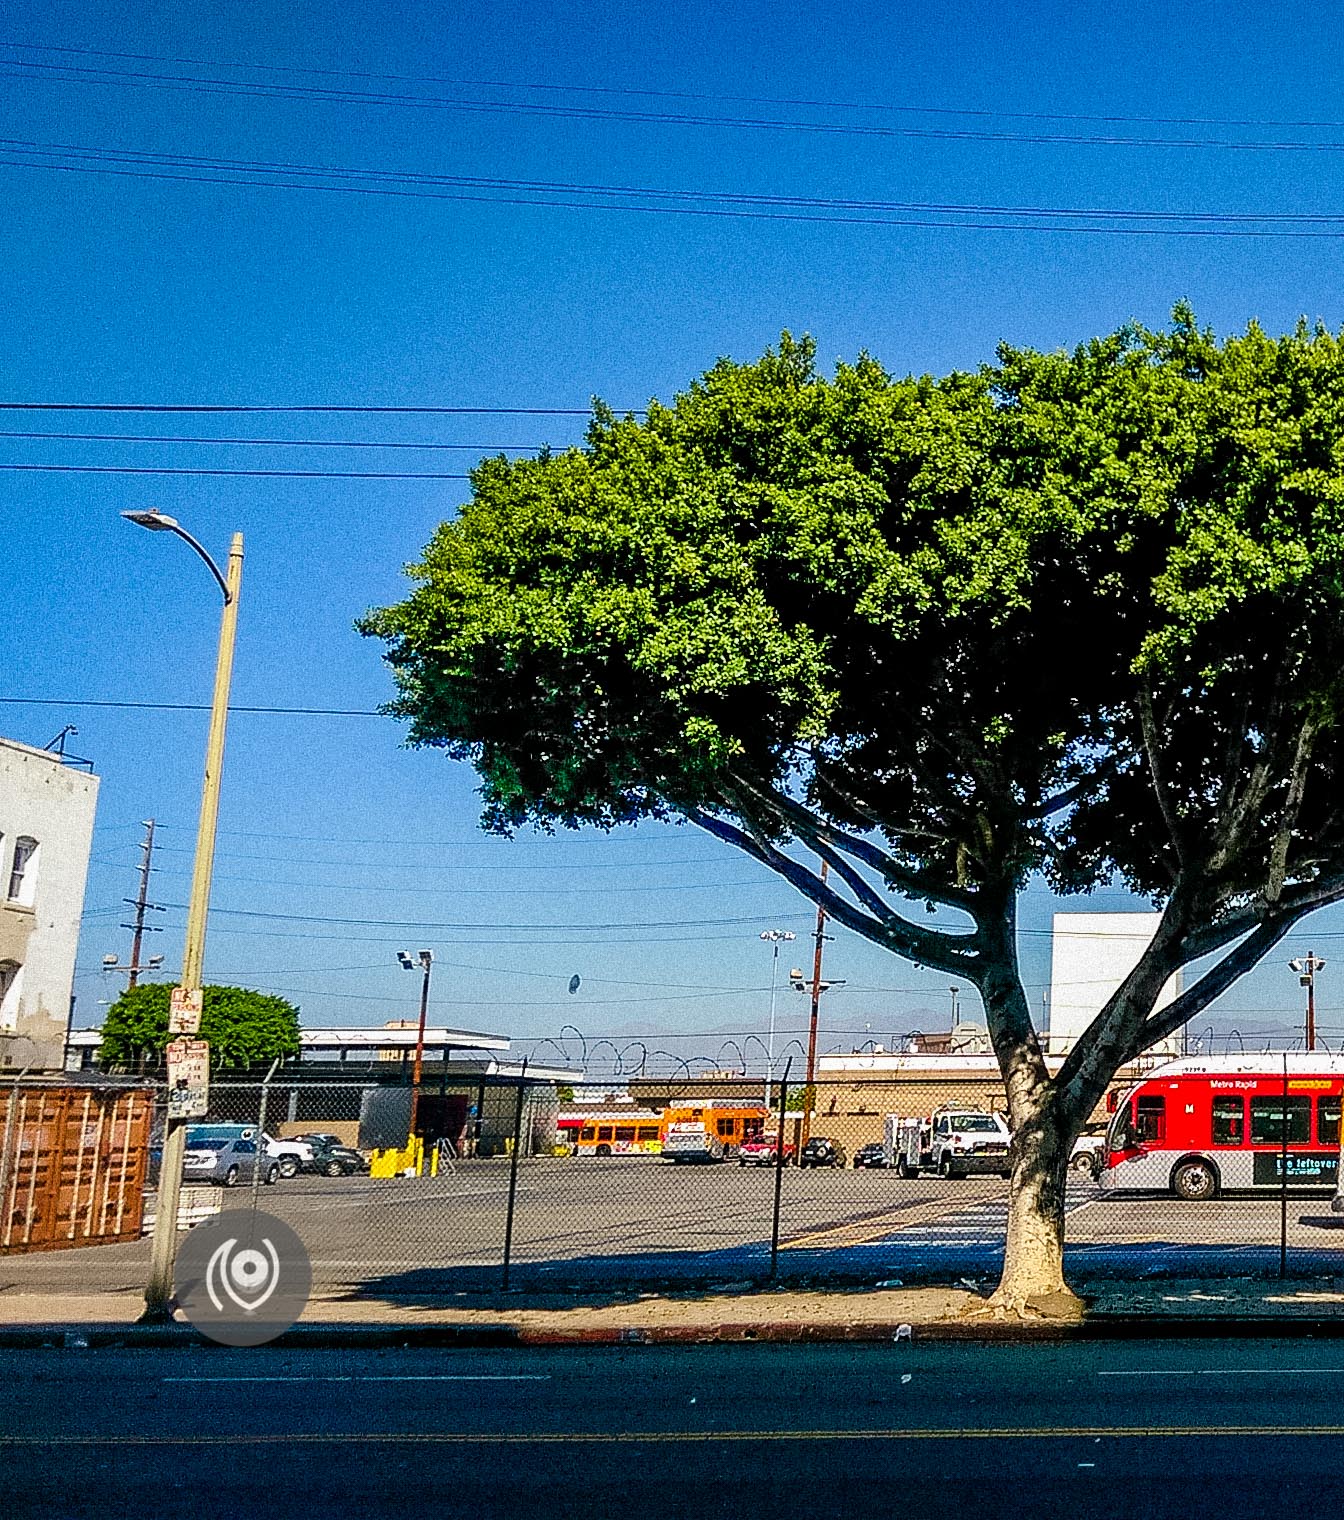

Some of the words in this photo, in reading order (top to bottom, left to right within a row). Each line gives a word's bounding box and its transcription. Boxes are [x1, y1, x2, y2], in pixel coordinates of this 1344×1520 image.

[1210, 1080, 1234, 1089] Metro
[1235, 1081, 1257, 1090] Rapid
[1296, 1158, 1339, 1168] leftover
